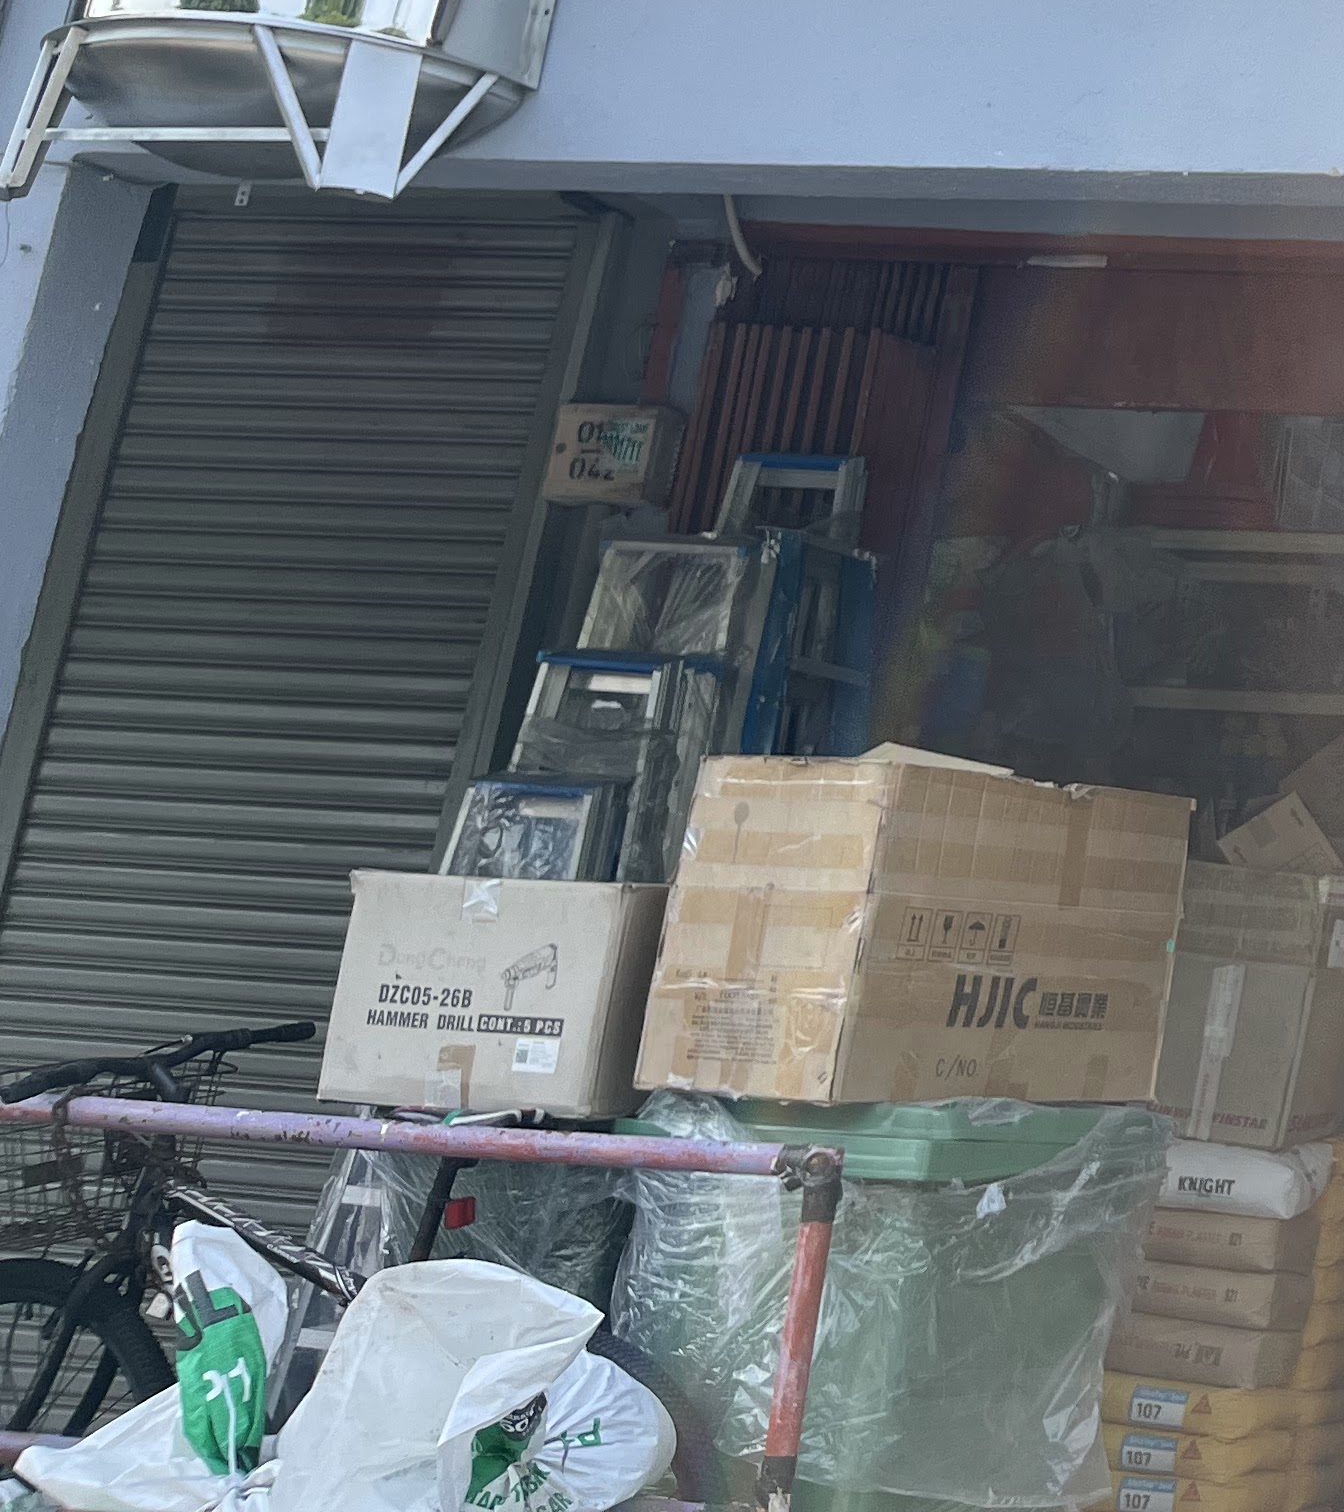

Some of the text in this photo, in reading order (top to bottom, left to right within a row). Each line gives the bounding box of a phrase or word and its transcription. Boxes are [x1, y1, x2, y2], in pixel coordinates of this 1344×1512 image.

[377, 983, 474, 1009] DZC05-26B
[366, 1008, 430, 1030] HAMMER
[437, 1013, 475, 1032] DRILL
[535, 1019, 561, 1035] PCS
[1177, 1175, 1236, 1196] KNIGHT
[1136, 1402, 1163, 1420] 107
[1126, 1450, 1152, 1467] 107
[1124, 1492, 1151, 1510] 107
